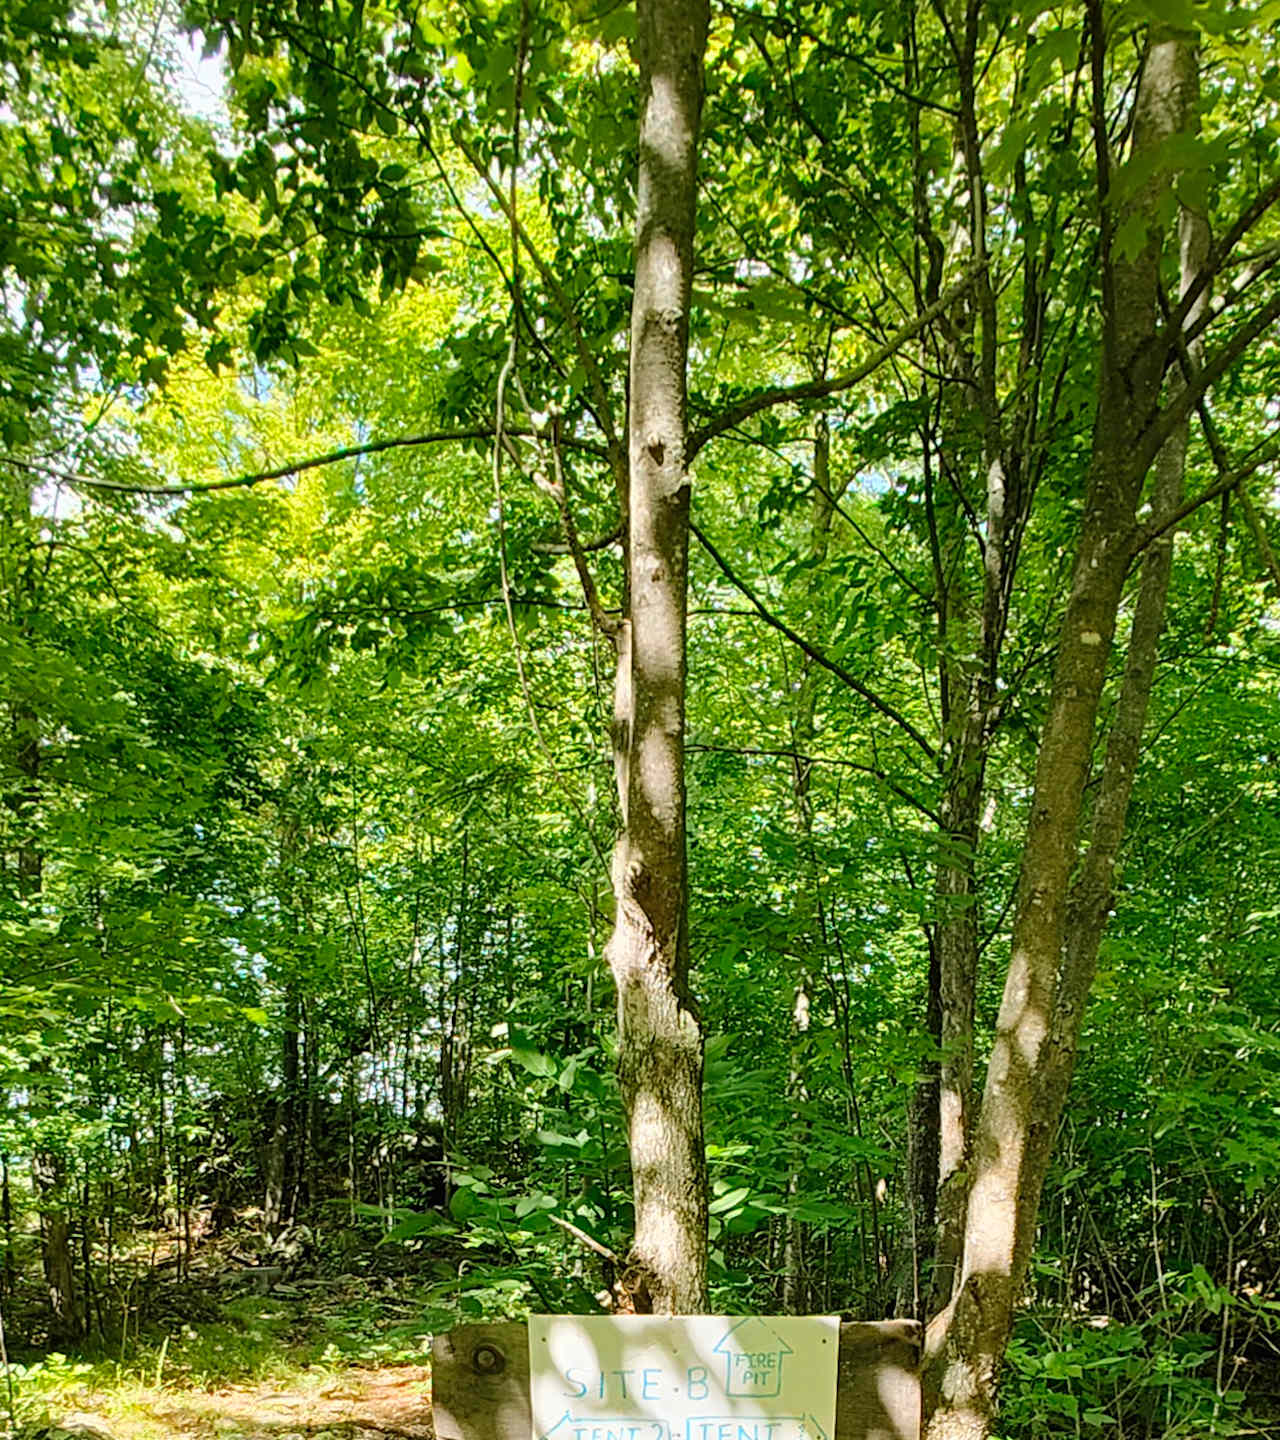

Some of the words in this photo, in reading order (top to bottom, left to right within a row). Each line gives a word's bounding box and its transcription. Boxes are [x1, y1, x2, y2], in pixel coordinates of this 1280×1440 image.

[734, 1352, 777, 1369] FIRE
[564, 1367, 663, 1400] SITE
[687, 1366, 710, 1401] B
[743, 1370, 770, 1386] PIT
